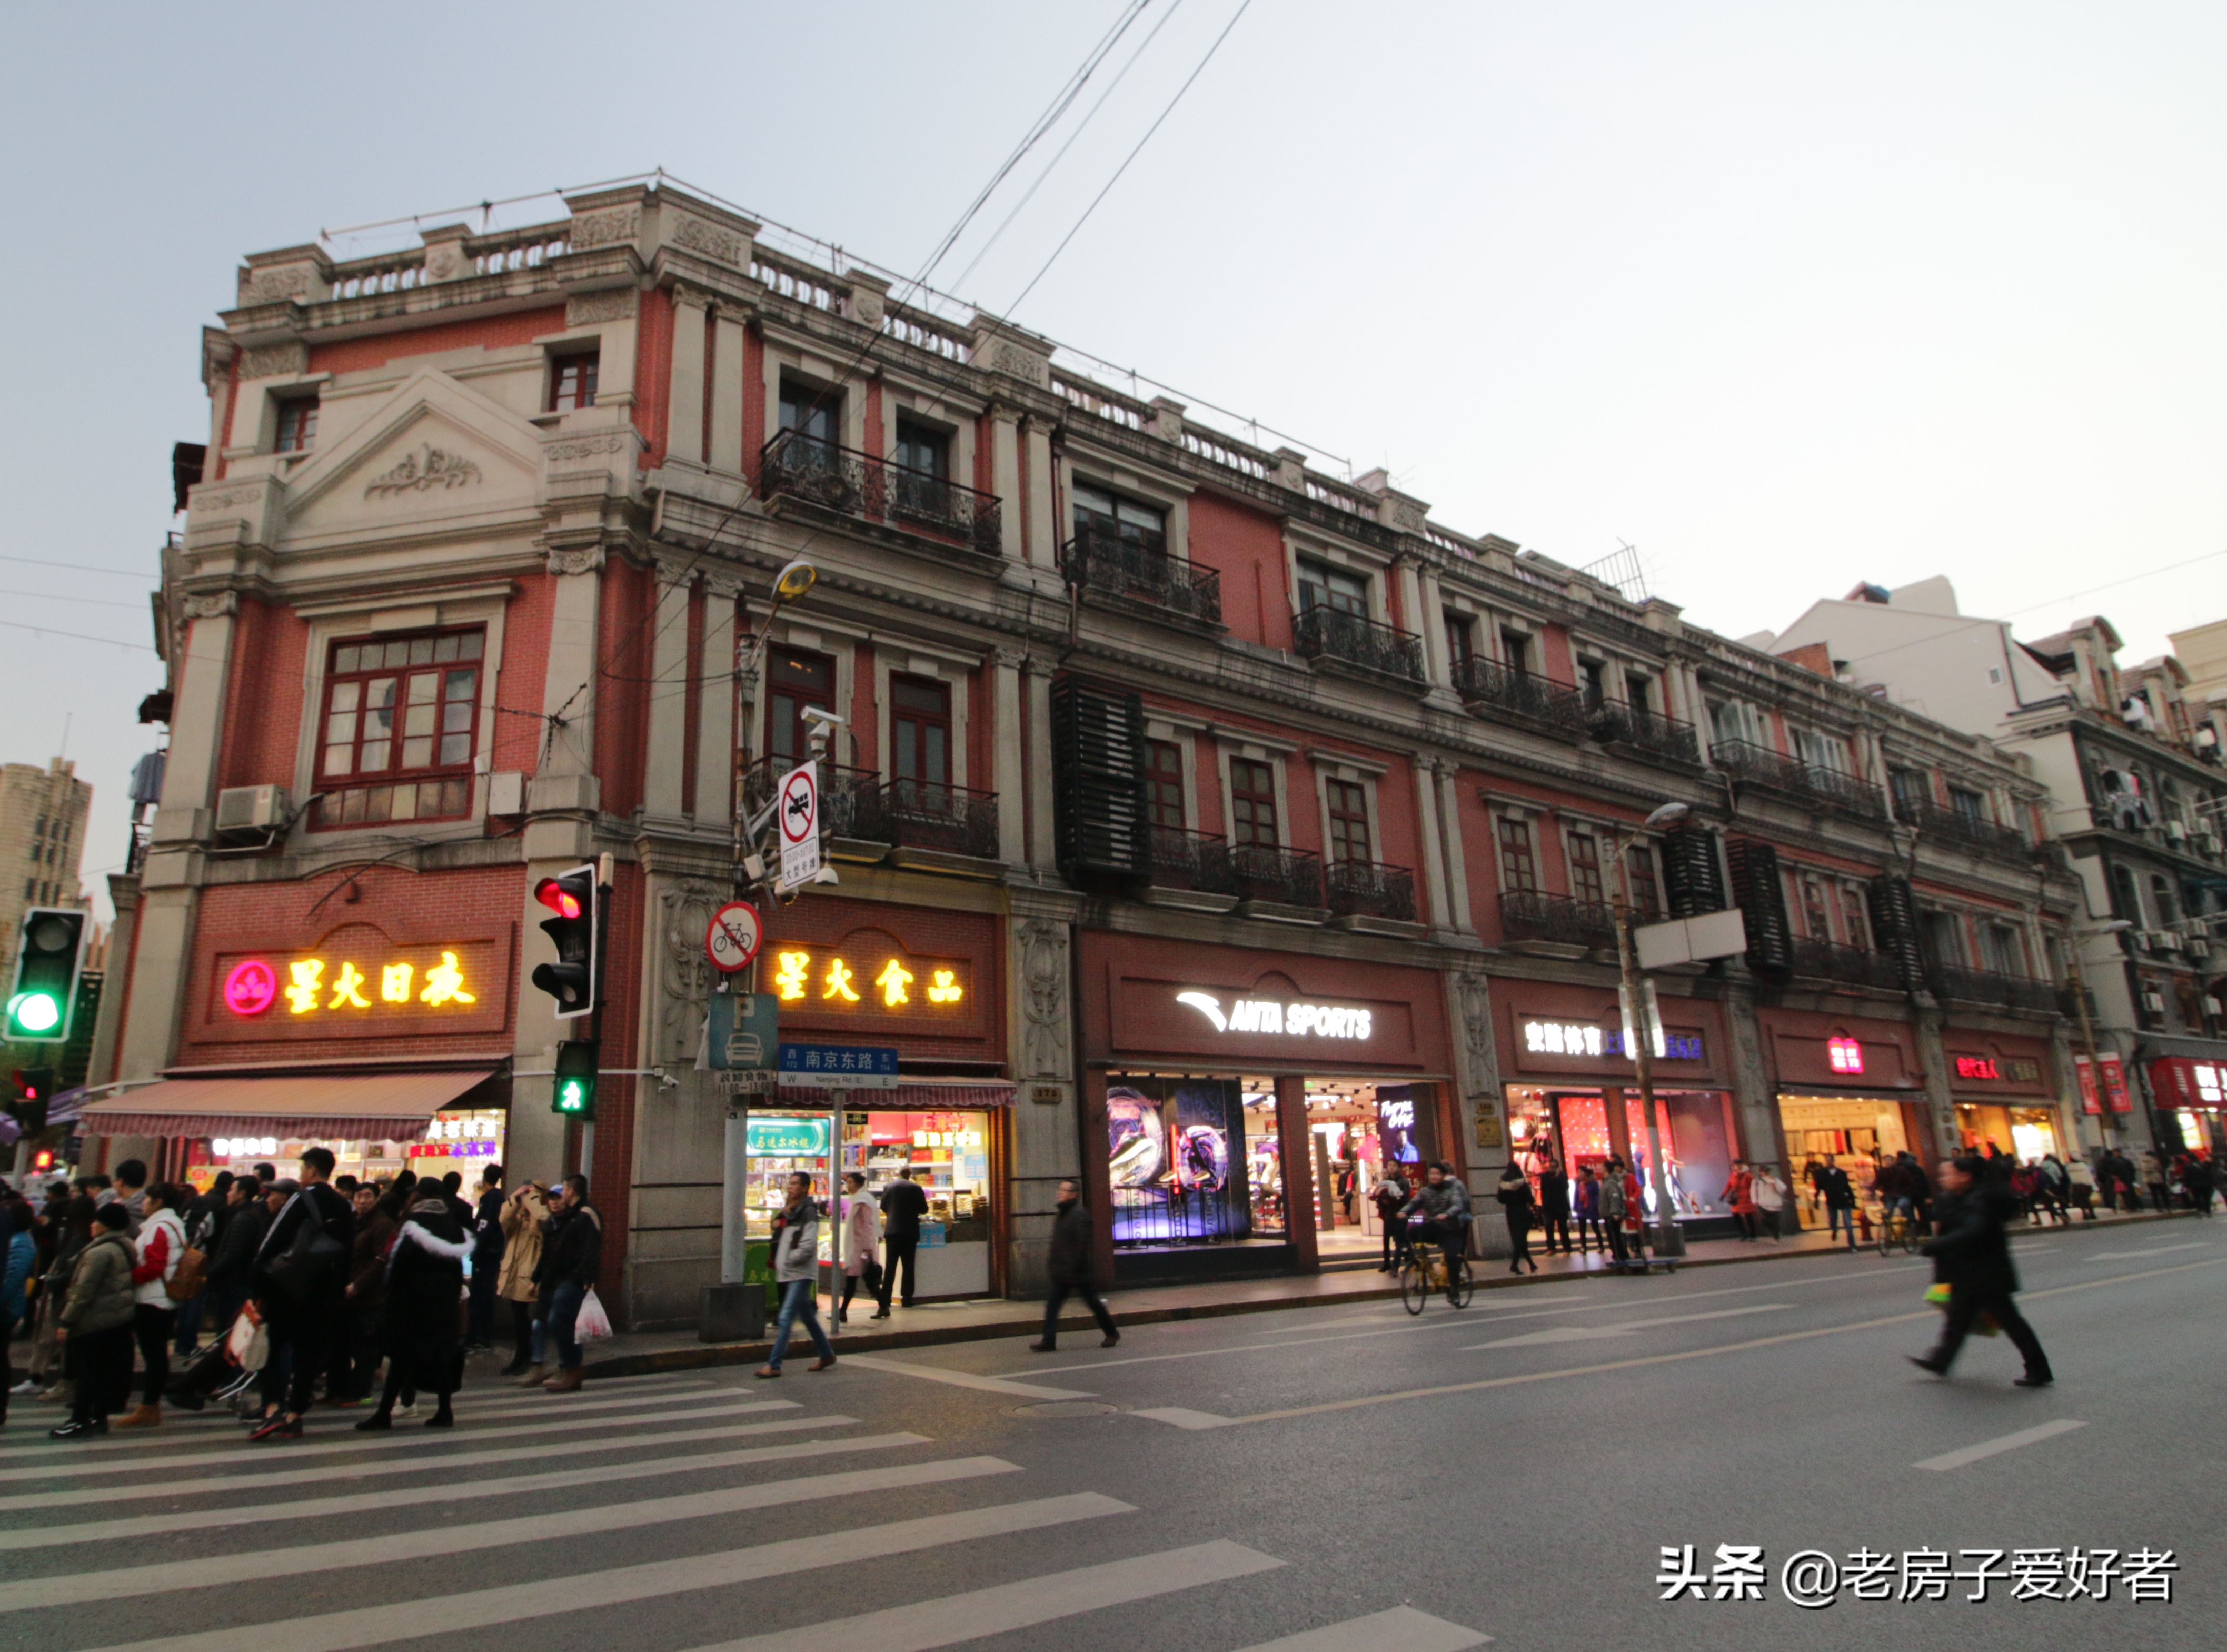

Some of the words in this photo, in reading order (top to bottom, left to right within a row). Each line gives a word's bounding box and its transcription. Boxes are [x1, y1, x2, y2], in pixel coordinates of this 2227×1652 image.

[285, 952, 476, 1014] 星火日夜
[775, 952, 962, 1007] 星火食品
[734, 997, 755, 1029] P
[1229, 1000, 1282, 1033] ANTA
[1286, 1003, 1371, 1039] SPORTS
[788, 1049, 797, 1059] 西
[806, 1050, 873, 1070] 南京东路
[881, 1053, 890, 1063] 东
[787, 1075, 796, 1083] W
[816, 1076, 840, 1085] Nanjing
[883, 1078, 889, 1086] E
